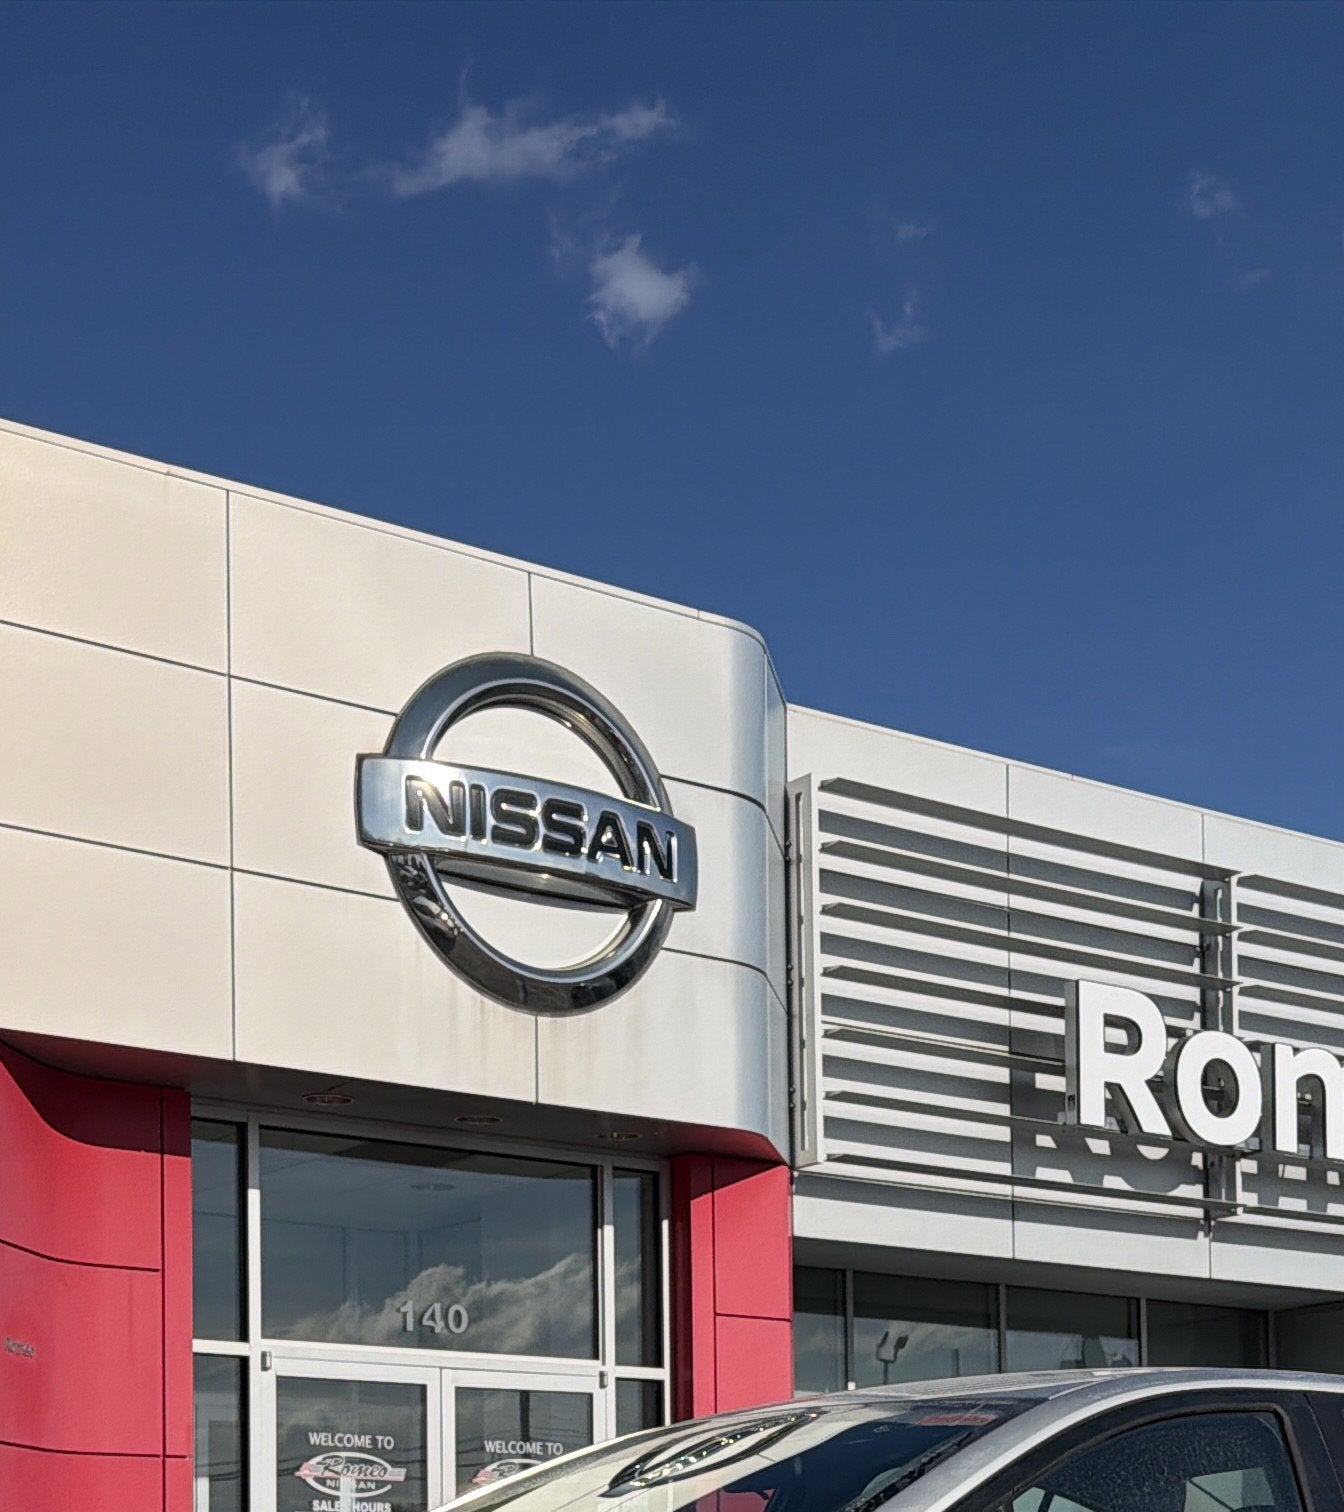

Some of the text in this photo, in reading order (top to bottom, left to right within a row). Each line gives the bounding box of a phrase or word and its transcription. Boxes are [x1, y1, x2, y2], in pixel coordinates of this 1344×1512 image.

[404, 774, 678, 883] NISSAN
[399, 1300, 469, 1334] 140
[308, 1431, 395, 1450] WELCOME TO
[483, 1440, 564, 1456] WELCOME TO
[316, 1454, 389, 1479] Romeo
[312, 1499, 344, 1512] SALE
